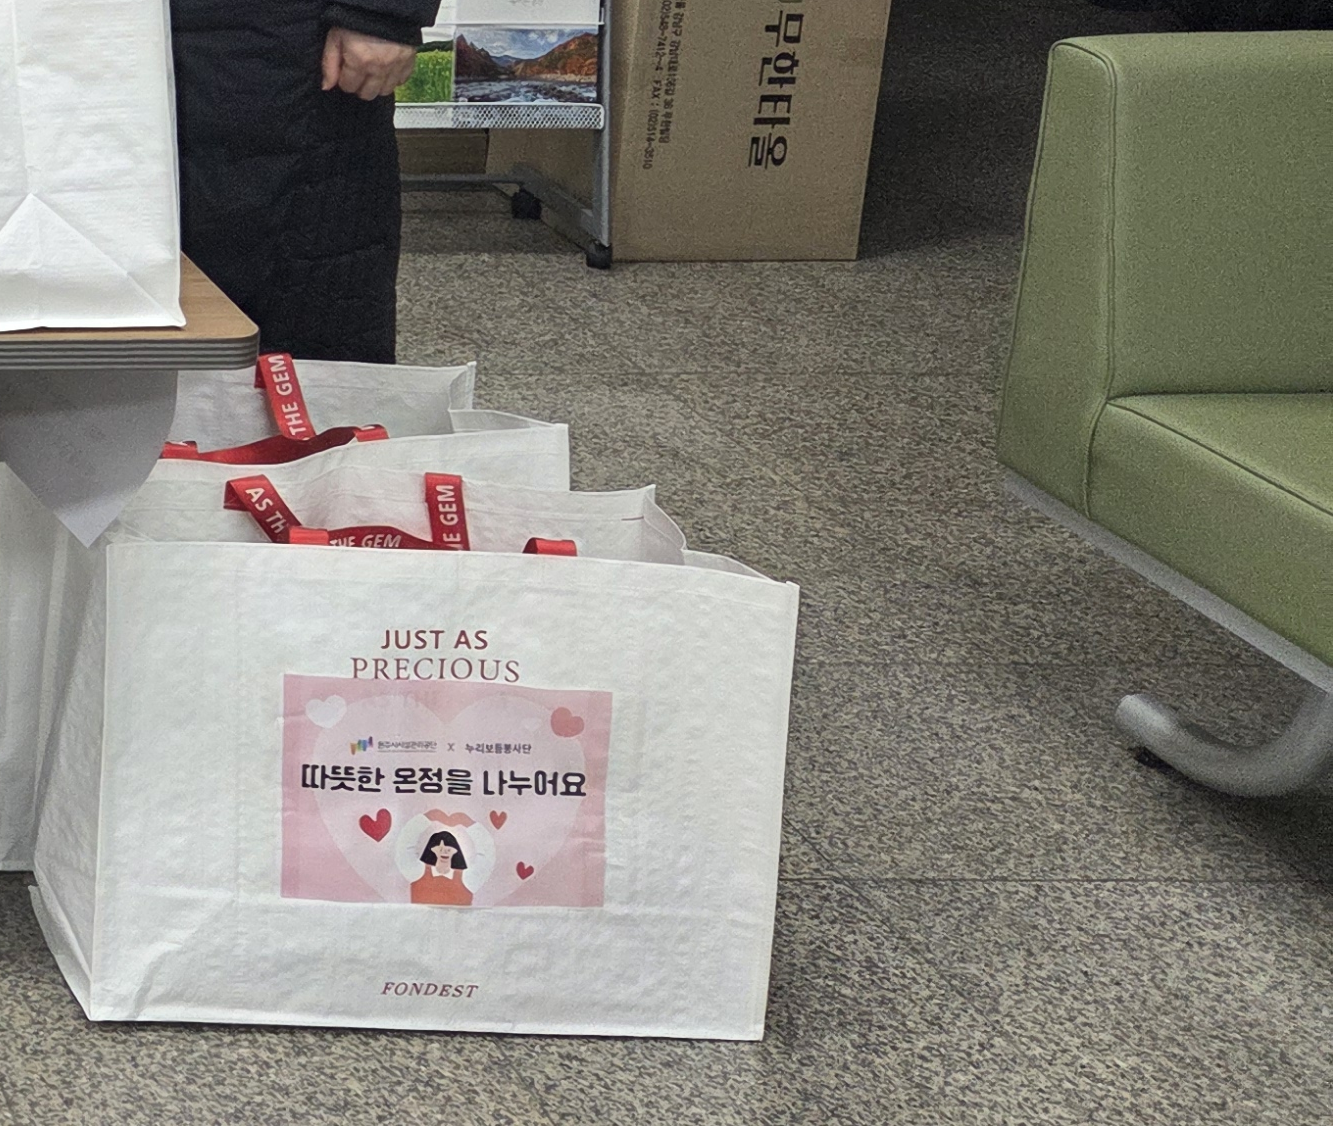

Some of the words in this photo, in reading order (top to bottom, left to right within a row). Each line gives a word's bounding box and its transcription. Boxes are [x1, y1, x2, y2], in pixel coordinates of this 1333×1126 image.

[651, 80, 663, 100] FAX
[748, 9, 805, 170] 무한타올
[267, 354, 293, 396] GEM
[281, 401, 307, 436] THE
[245, 487, 273, 512] AS
[435, 484, 459, 526] GEM
[381, 629, 445, 650] JUST
[453, 630, 489, 650] AS
[351, 657, 521, 683] PRECIOUS
[301, 763, 385, 793] 따뜻한
[392, 767, 473, 796] 온정을
[482, 769, 587, 797] 나누어요
[381, 982, 479, 998] FONDEST
